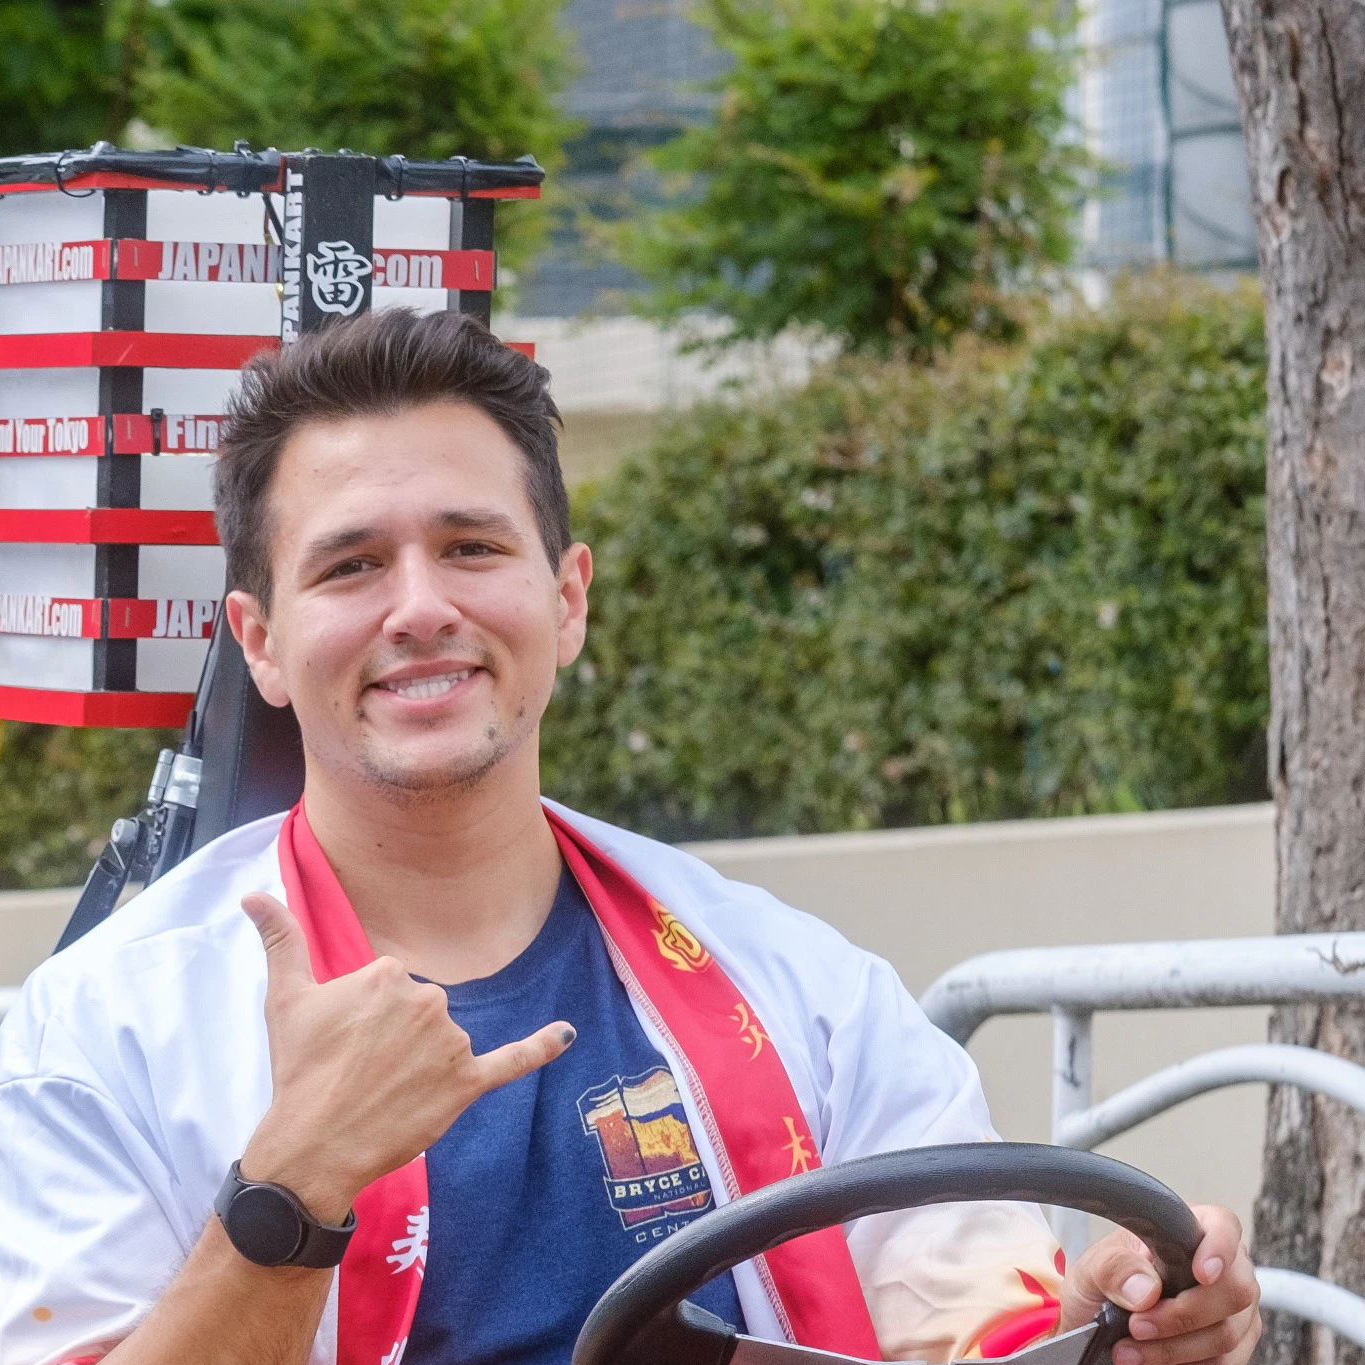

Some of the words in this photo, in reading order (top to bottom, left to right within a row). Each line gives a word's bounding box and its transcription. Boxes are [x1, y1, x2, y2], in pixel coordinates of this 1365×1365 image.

[306, 240, 373, 316] 雷
[16, 419, 46, 453] Your
[47, 417, 89, 454] Tokyo
[166, 415, 221, 450] Fin
[614, 1173, 683, 1199] BRYCE
